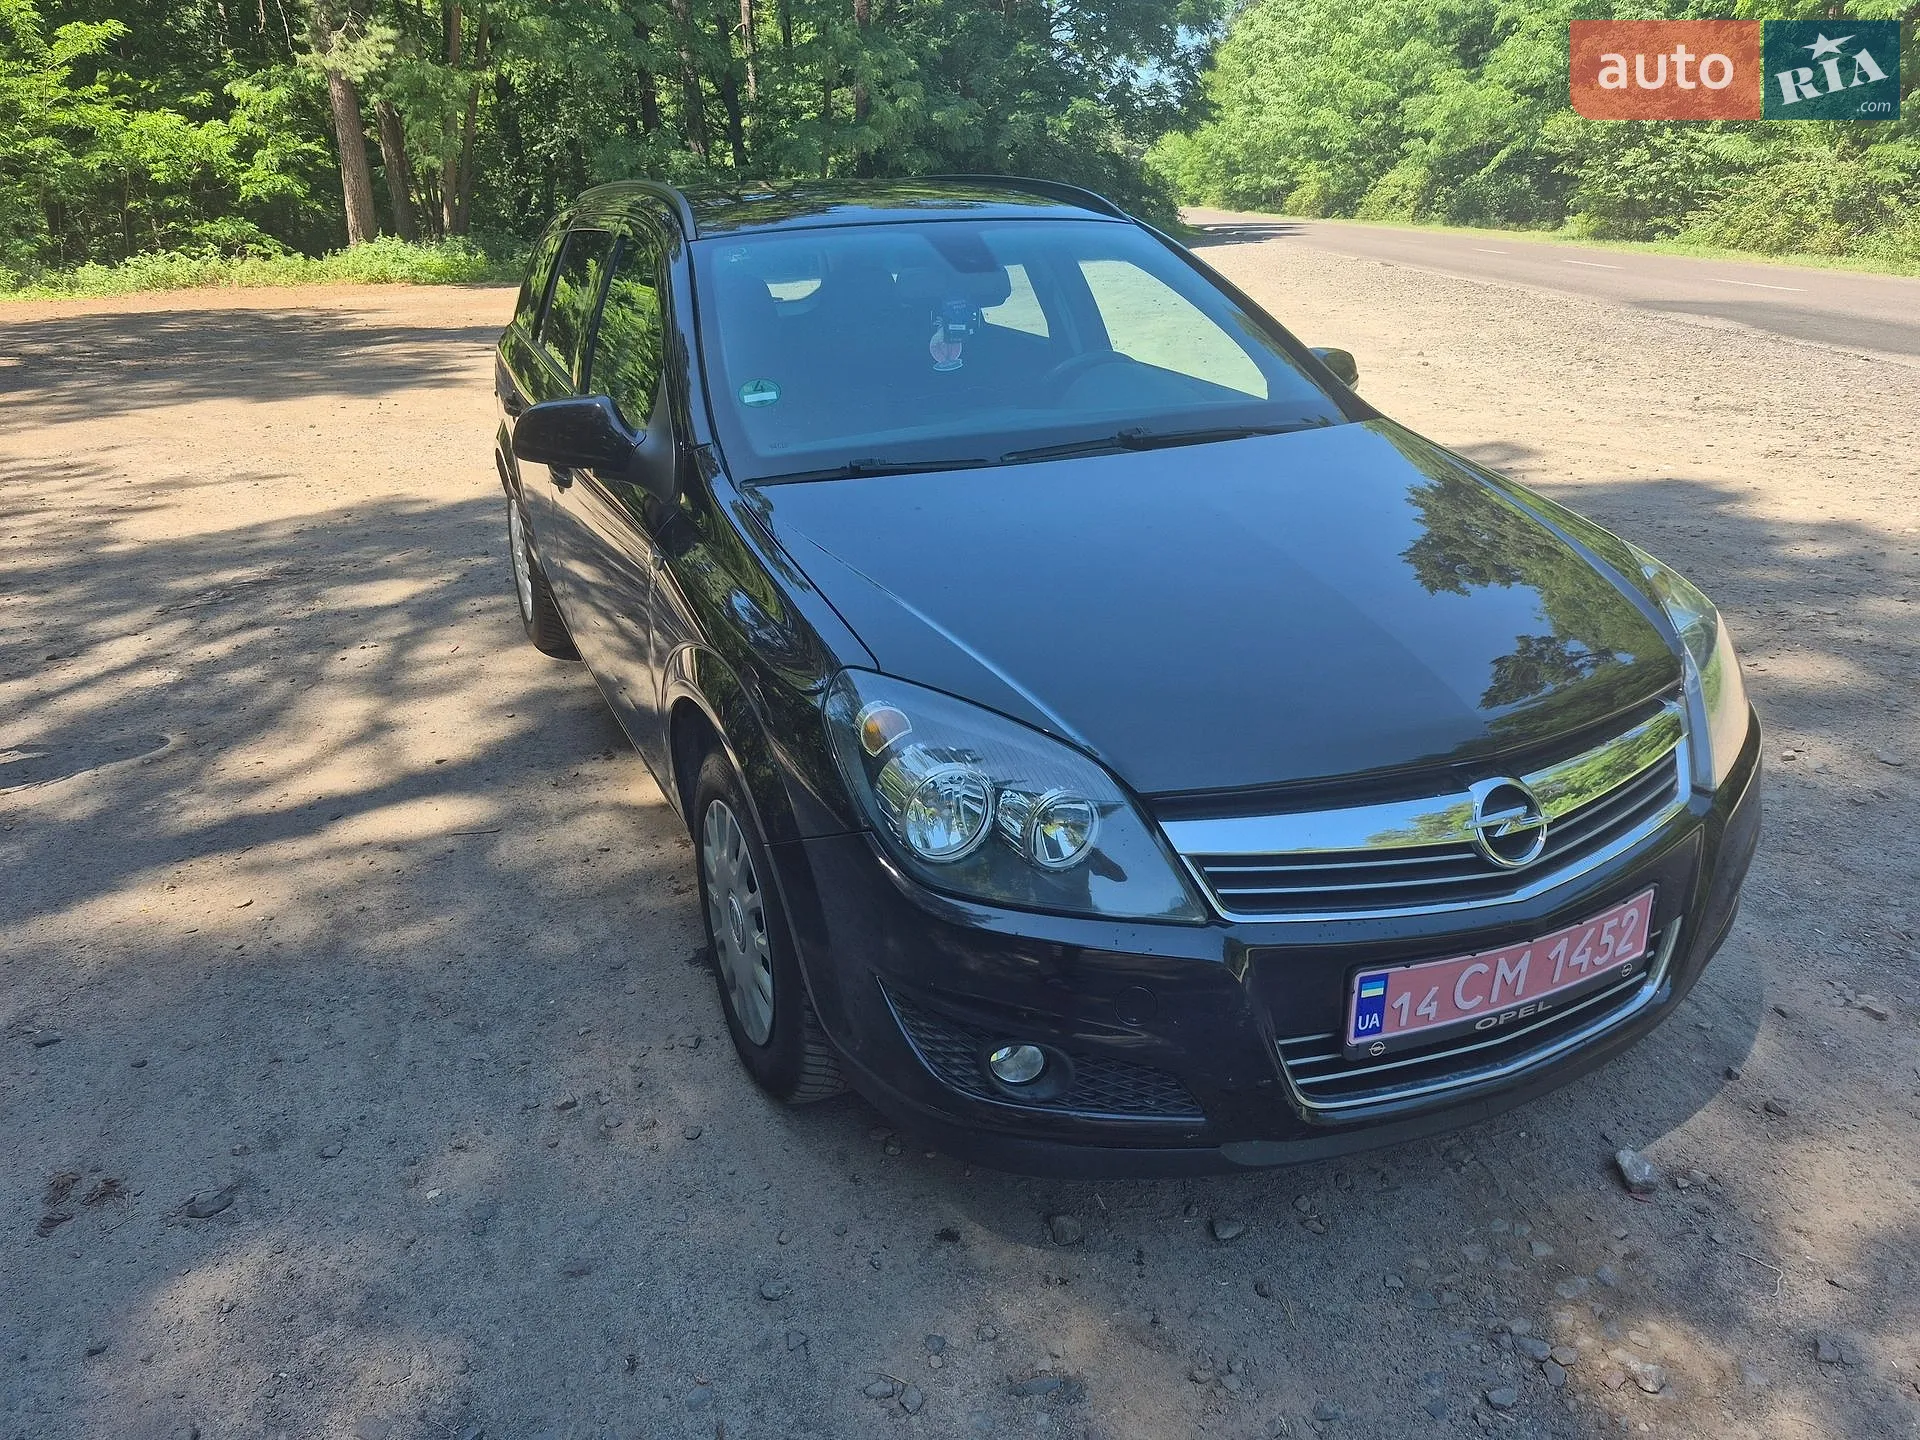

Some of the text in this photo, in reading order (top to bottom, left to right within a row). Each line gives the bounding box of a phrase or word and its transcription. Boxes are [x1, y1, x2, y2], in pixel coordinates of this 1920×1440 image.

[1391, 908, 1639, 1027] 14 CM 1452
[1358, 1013, 1380, 1031] UA
[1474, 1001, 1552, 1030] OPEL
